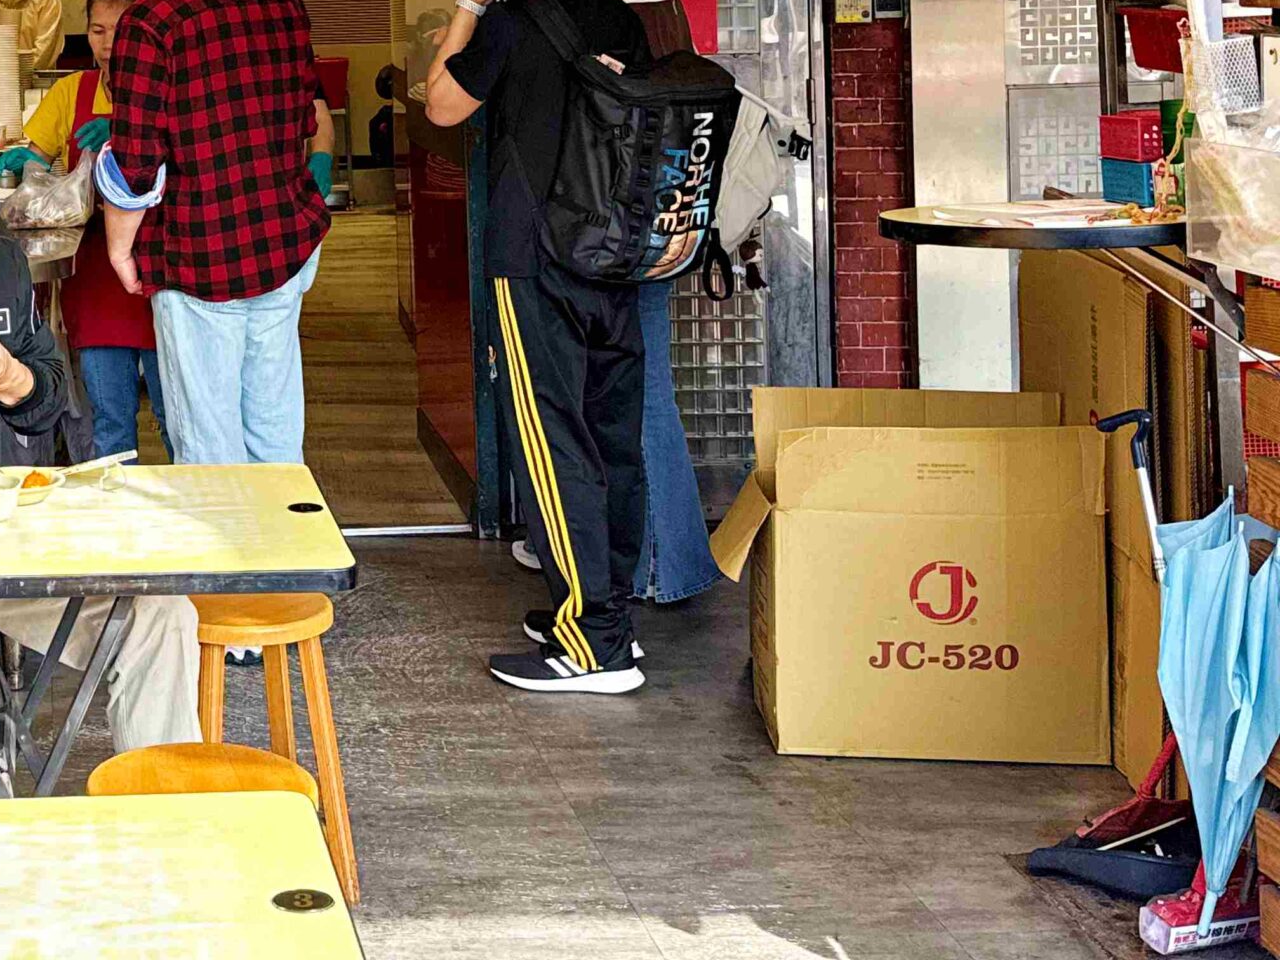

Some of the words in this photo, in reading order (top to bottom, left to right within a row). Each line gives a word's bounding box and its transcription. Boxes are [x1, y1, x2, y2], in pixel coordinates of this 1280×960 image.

[651, 148, 689, 232] FACE
[869, 641, 1020, 671] JC-520
[293, 893, 313, 908] 3
